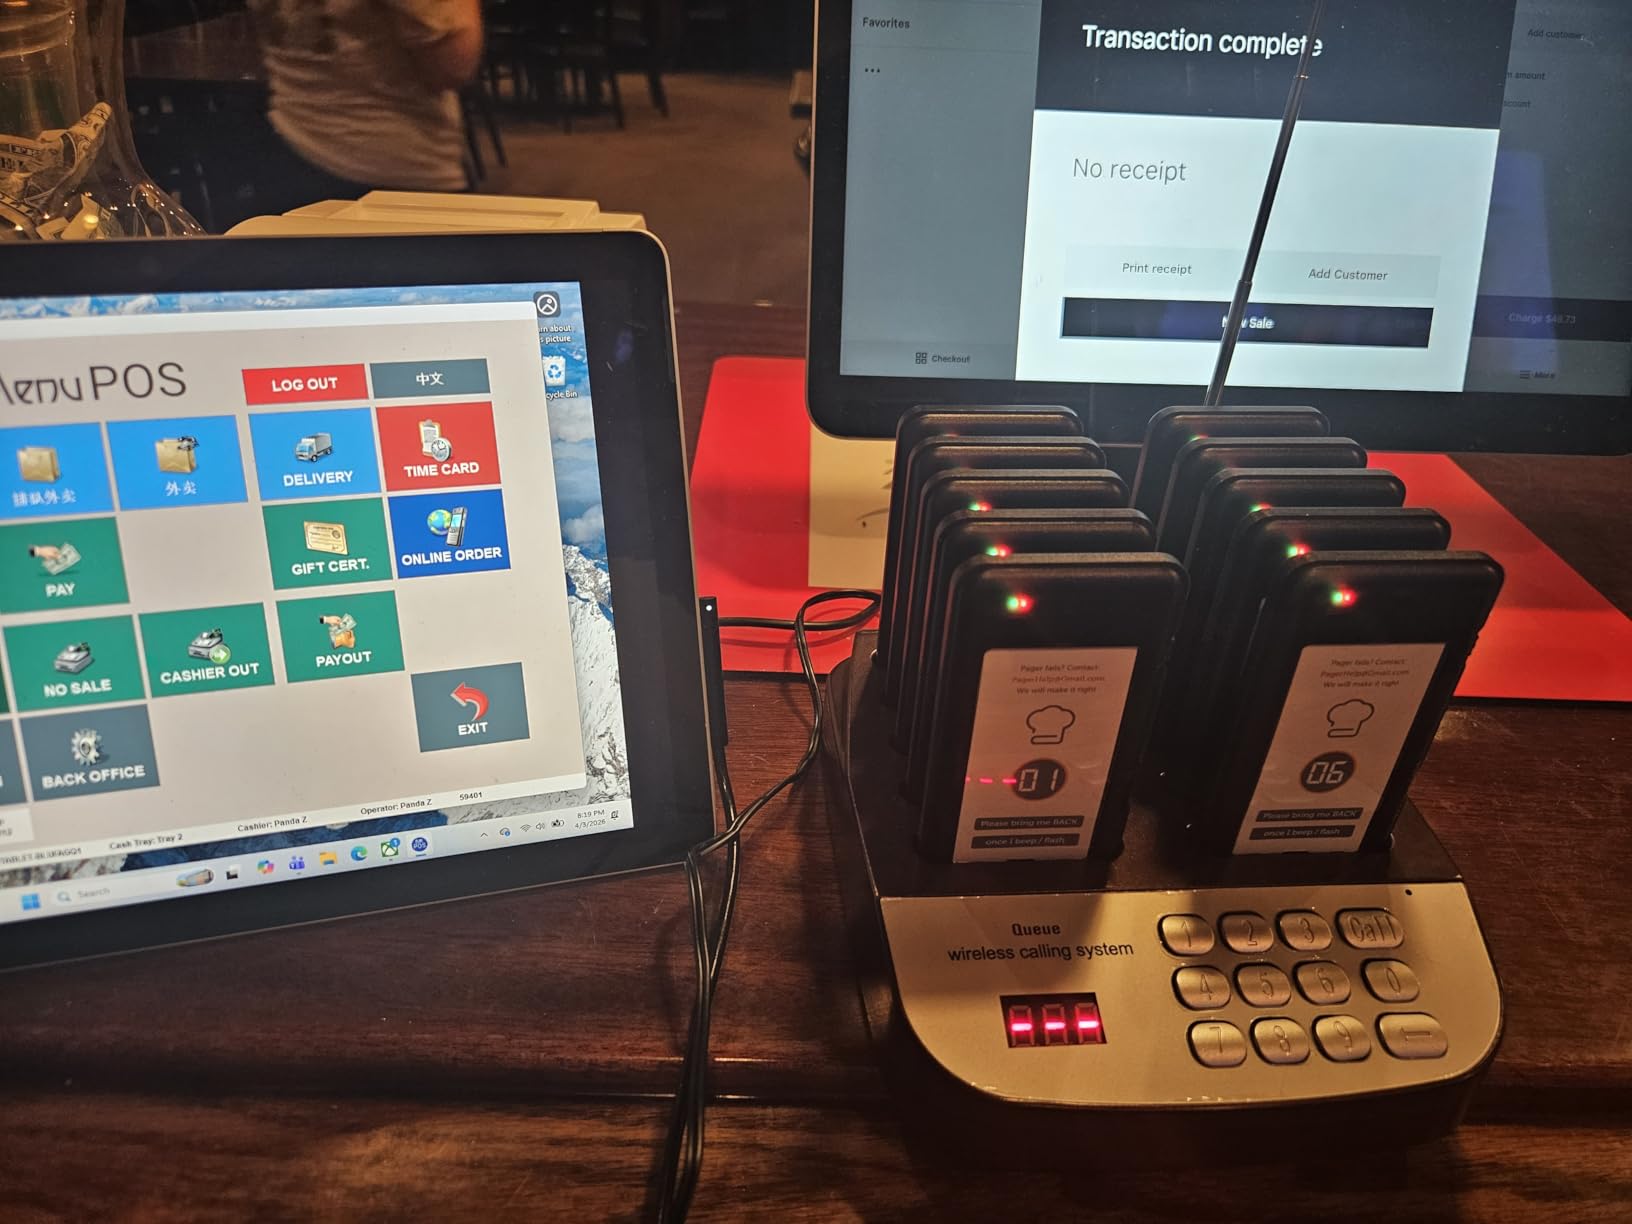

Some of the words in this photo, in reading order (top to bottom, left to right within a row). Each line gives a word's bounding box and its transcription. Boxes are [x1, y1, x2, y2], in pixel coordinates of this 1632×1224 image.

[862, 17, 910, 30] Favorites
[1528, 28, 1543, 38] Add
[1082, 24, 1213, 53] Transaction
[1218, 32, 1323, 60] complete
[1515, 71, 1546, 81] amount
[1072, 157, 1102, 179] No
[1110, 159, 1188, 185] receipt
[1122, 262, 1149, 274] Print
[1152, 263, 1192, 276] receipt
[1308, 268, 1331, 280] Add
[1334, 269, 1388, 282] Customer
[1222, 316, 1248, 329] Nw
[1249, 316, 1275, 329] Sale
[1509, 312, 1543, 325] Charge
[550, 324, 572, 334] about
[545, 334, 571, 344] picture
[931, 353, 971, 365] Checkout
[271, 378, 304, 393] LOG
[308, 376, 339, 390] OUT
[416, 371, 444, 387] 中文
[564, 389, 578, 399] Bin
[403, 464, 438, 478] TIME
[442, 461, 480, 476] CARD
[283, 470, 353, 488] DELIVERY
[165, 479, 198, 497] 外卖
[401, 550, 452, 566] ONLINE
[454, 546, 502, 562] ORDER
[291, 560, 325, 576] GIFT
[328, 558, 370, 573] CERT.
[45, 583, 76, 598] PAY
[315, 650, 373, 668] PAYOUT
[160, 665, 227, 685] CASHIER
[228, 662, 260, 677] OUT
[1020, 664, 1043, 673] Pager
[43, 683, 68, 698] NO
[70, 679, 112, 695] SALE
[1047, 686, 1068, 694] make
[458, 721, 489, 736] EXIT
[41, 770, 87, 789] BACK
[88, 765, 146, 784] OFFICE
[1018, 769, 1059, 792] 01
[1306, 760, 1348, 785] 06
[459, 791, 483, 801] 59401
[360, 803, 399, 816] Operator:
[400, 799, 425, 809] Panda
[426, 798, 433, 806] Z
[577, 810, 591, 819] 8:19
[592, 808, 605, 817] PM
[1263, 812, 1291, 820] Please
[1332, 810, 1356, 818] BACK
[237, 820, 273, 833] Cashier:
[274, 817, 301, 829] Panda
[301, 816, 308, 824] Z
[574, 819, 606, 830] 4/3/2026
[980, 819, 1008, 827] Please
[1010, 819, 1034, 828] bring
[1053, 818, 1078, 826] BACK
[1292, 828, 1314, 837] beep
[1320, 827, 1340, 835] flash
[109, 840, 132, 851] Cash
[135, 837, 156, 848] Tray:
[157, 834, 176, 847] Tray
[177, 833, 184, 841] 2
[985, 838, 1007, 846] once
[1014, 836, 1037, 846] beep
[78, 887, 110, 899] Search
[1012, 922, 1061, 937] Queue
[1182, 919, 1192, 947] 1
[1242, 919, 1258, 946] 2
[1300, 917, 1315, 943] 3
[1348, 914, 1397, 942] Call
[948, 945, 1015, 962] wireless
[1019, 943, 1072, 961] calling
[1076, 941, 1134, 960] system
[1199, 973, 1213, 1000] 4
[1259, 971, 1274, 999] 5
[1316, 967, 1335, 995] 6
[1383, 966, 1401, 994] 0
[1207, 1025, 1223, 1053] 7
[1273, 1024, 1291, 1053] 8
[1332, 1020, 1353, 1049] 9
